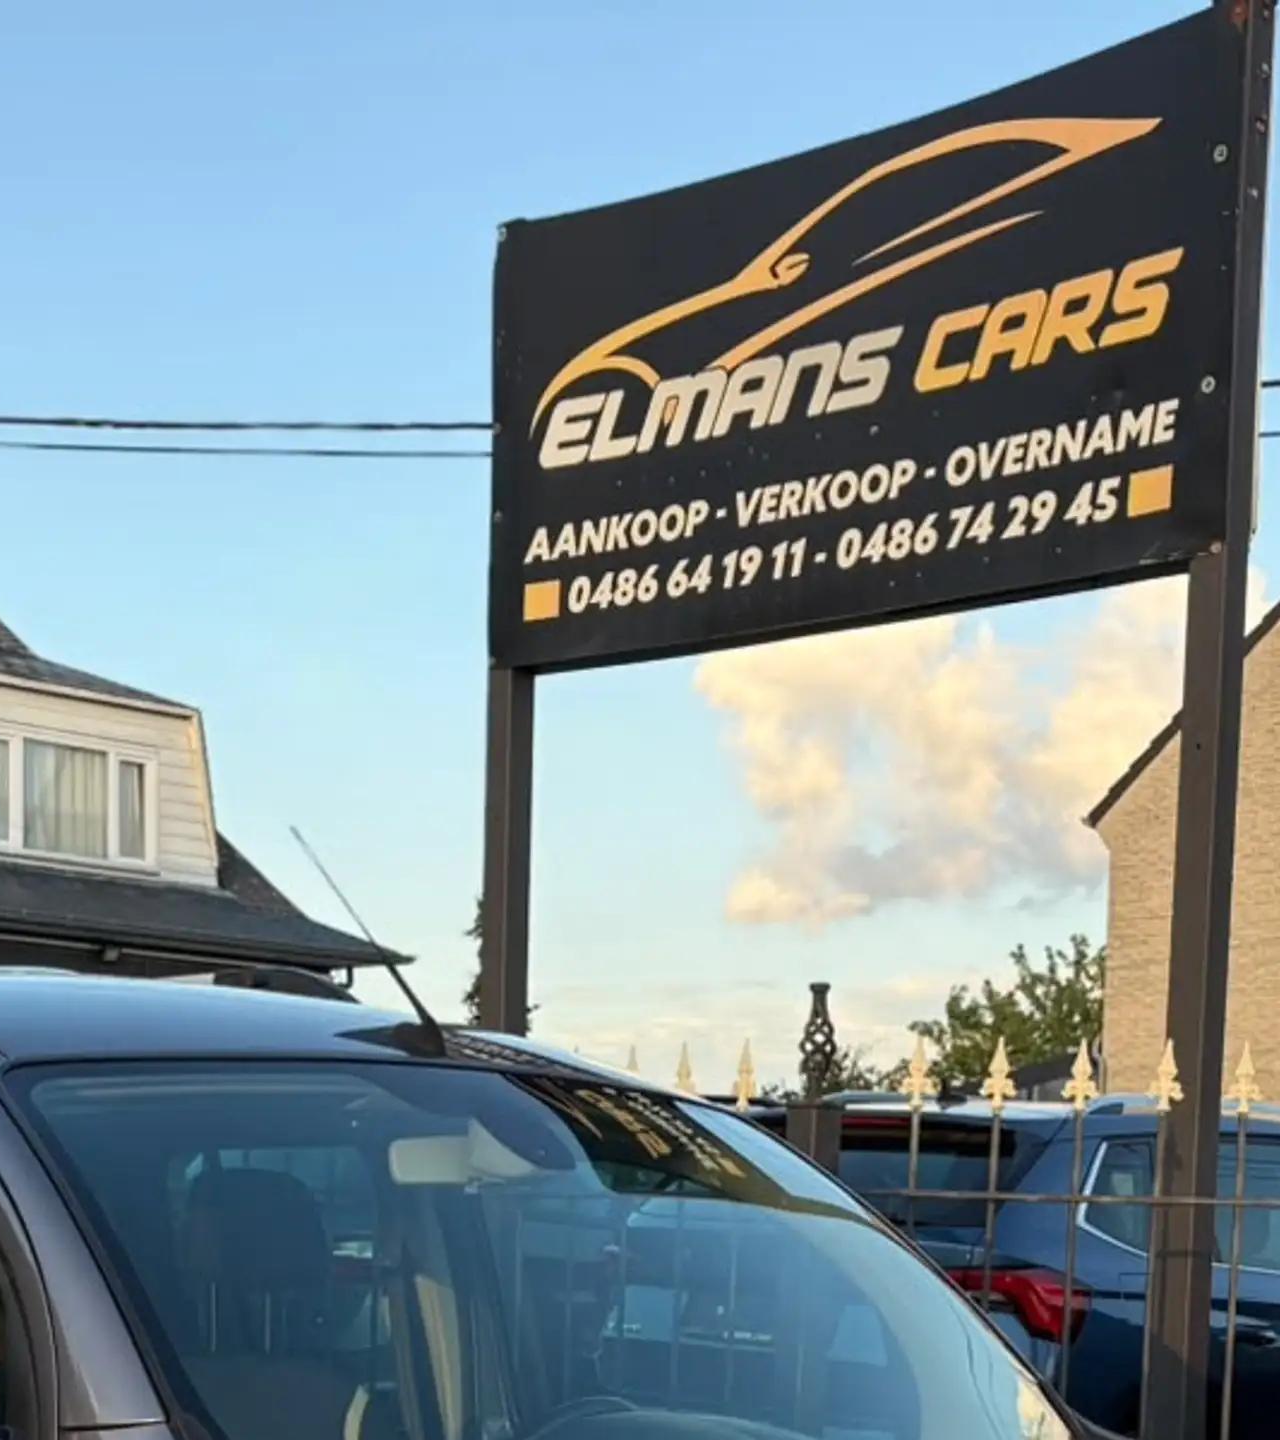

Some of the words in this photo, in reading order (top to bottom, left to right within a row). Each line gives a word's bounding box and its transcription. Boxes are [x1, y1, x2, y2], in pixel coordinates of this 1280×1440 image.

[538, 325, 904, 469] ELMANS
[913, 246, 1185, 392] CARS
[523, 499, 710, 565] AANKOOP
[735, 458, 918, 528] VERKOOP
[944, 398, 1180, 487] OVERNAME
[568, 564, 659, 614] 0486
[666, 554, 713, 598] 64
[721, 546, 763, 590] 19
[771, 537, 807, 580] 11
[836, 512, 939, 570] 0486
[946, 501, 995, 550] 74
[1000, 489, 1058, 540] 29
[1063, 476, 1122, 526] 45
